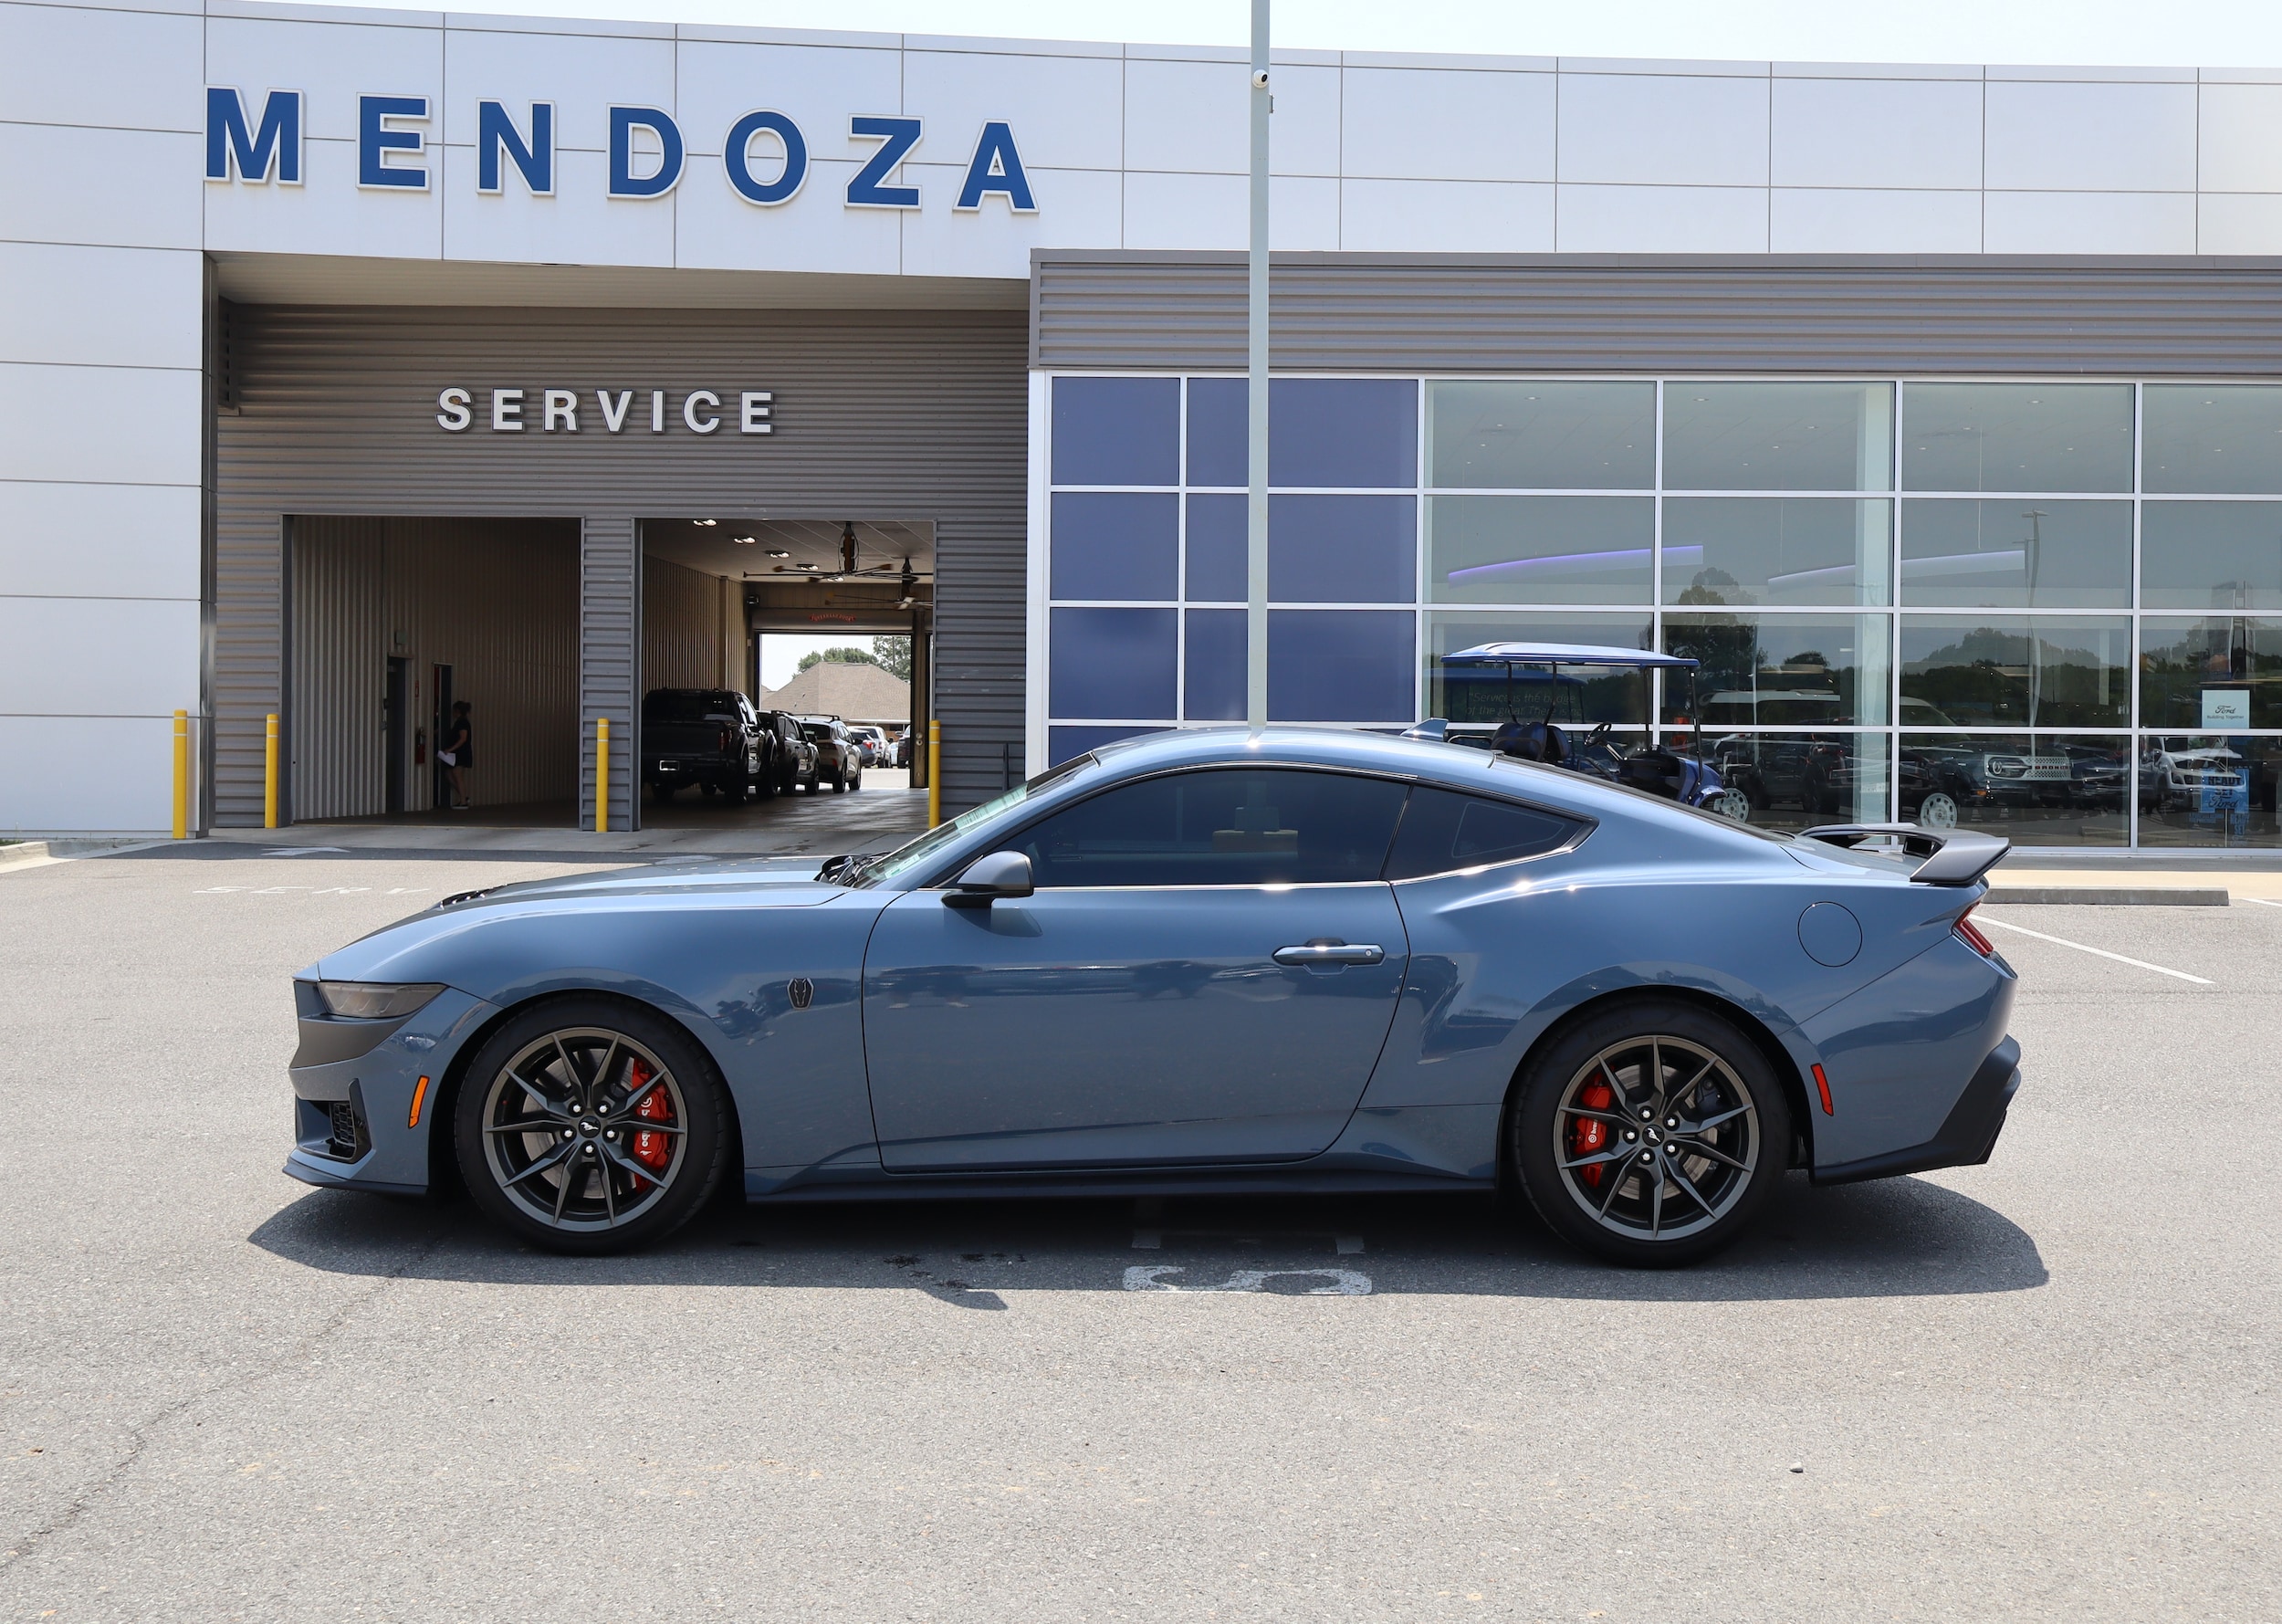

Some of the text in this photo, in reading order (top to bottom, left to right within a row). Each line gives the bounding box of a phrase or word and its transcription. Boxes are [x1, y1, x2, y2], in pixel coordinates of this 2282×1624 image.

[203, 84, 1040, 214] MENDOZA
[435, 386, 776, 435] SERVICE
[1513, 692, 1521, 703] is
[1524, 692, 1540, 703] the
[1544, 692, 1575, 707] bdge
[1465, 706, 1476, 716] of
[1479, 705, 1495, 715] the
[2214, 705, 2236, 714] Ford
[2208, 795, 2238, 809] Ford
